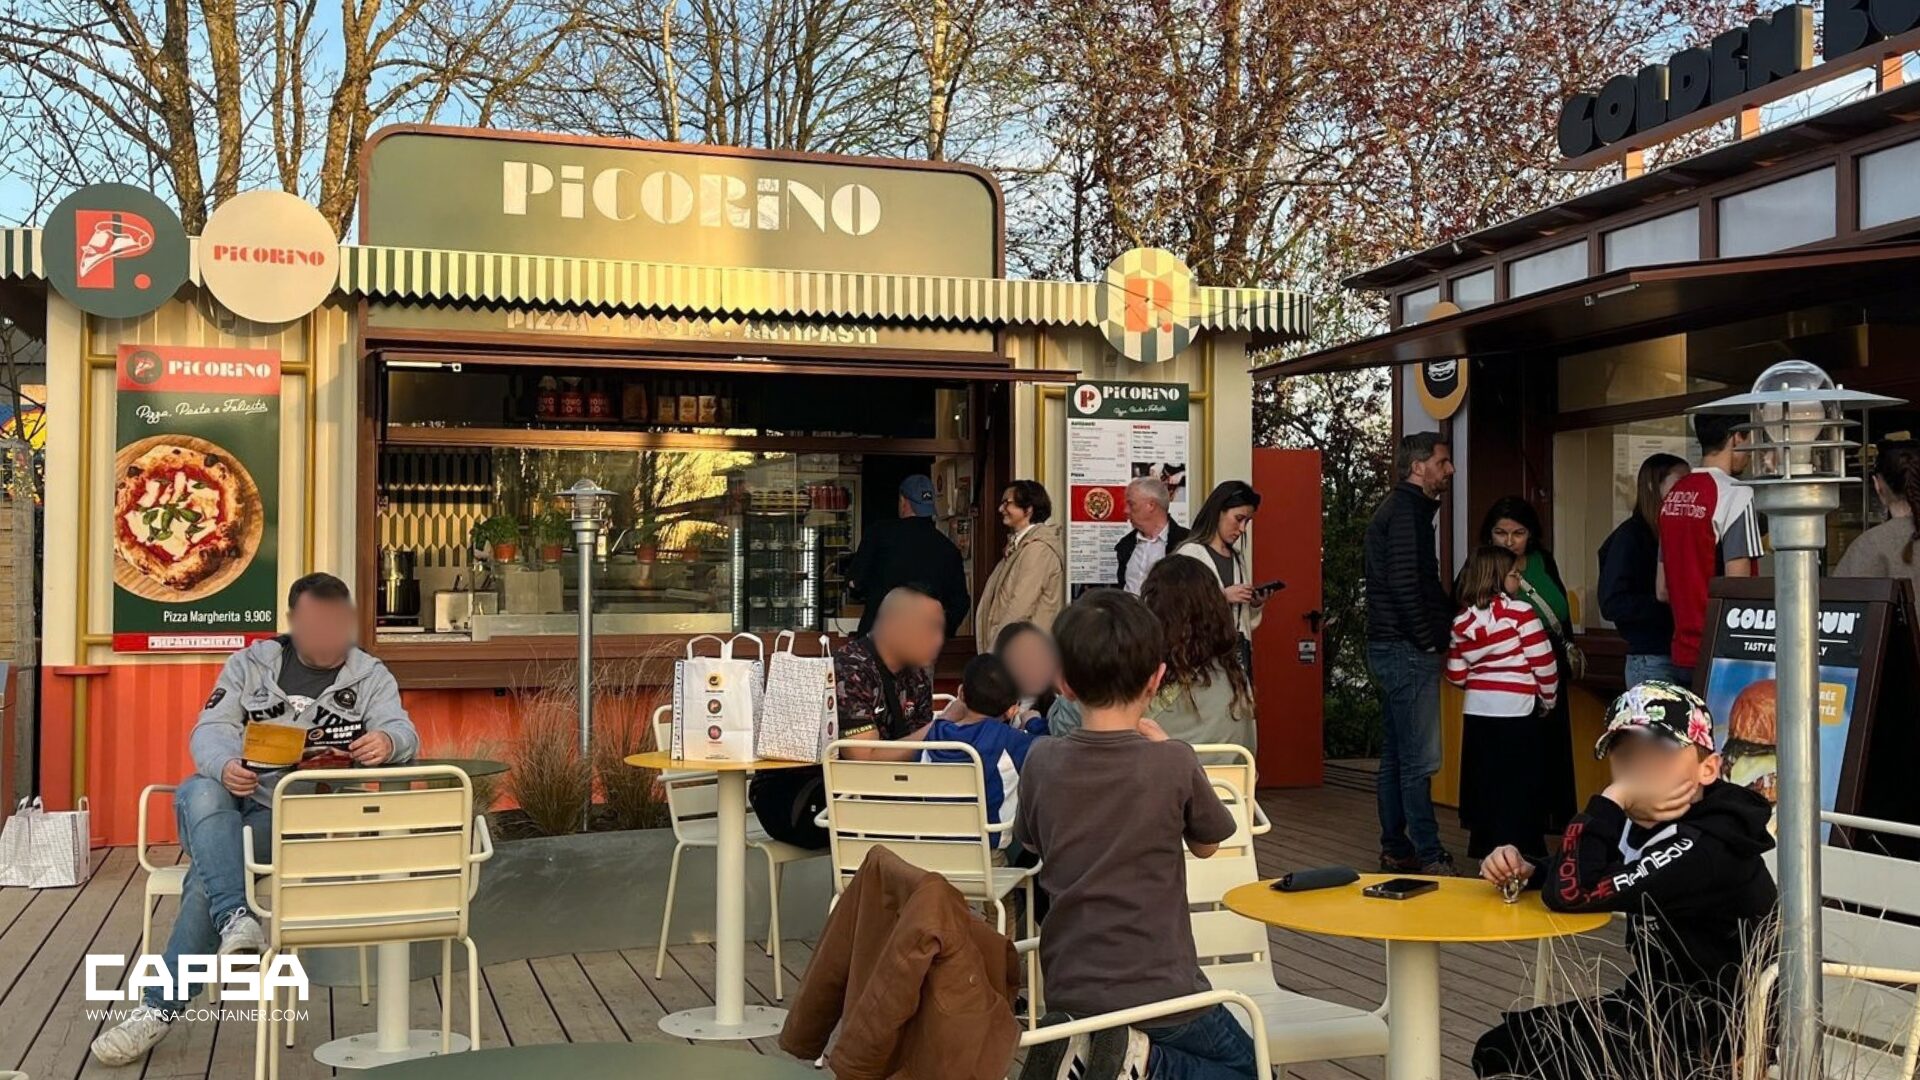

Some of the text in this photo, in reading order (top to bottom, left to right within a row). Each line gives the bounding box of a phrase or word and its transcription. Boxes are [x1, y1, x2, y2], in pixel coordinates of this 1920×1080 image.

[1558, 4, 1813, 157] GOLDEN
[176, 402, 211, 416] Pasta
[163, 610, 188, 622] Pizza
[190, 610, 240, 624] Margherita
[1726, 607, 1856, 634] GOLD UN
[1744, 642, 1767, 652] TASTY
[325, 723, 361, 734] GOLDEN
[1560, 823, 1584, 900] BEYOND
